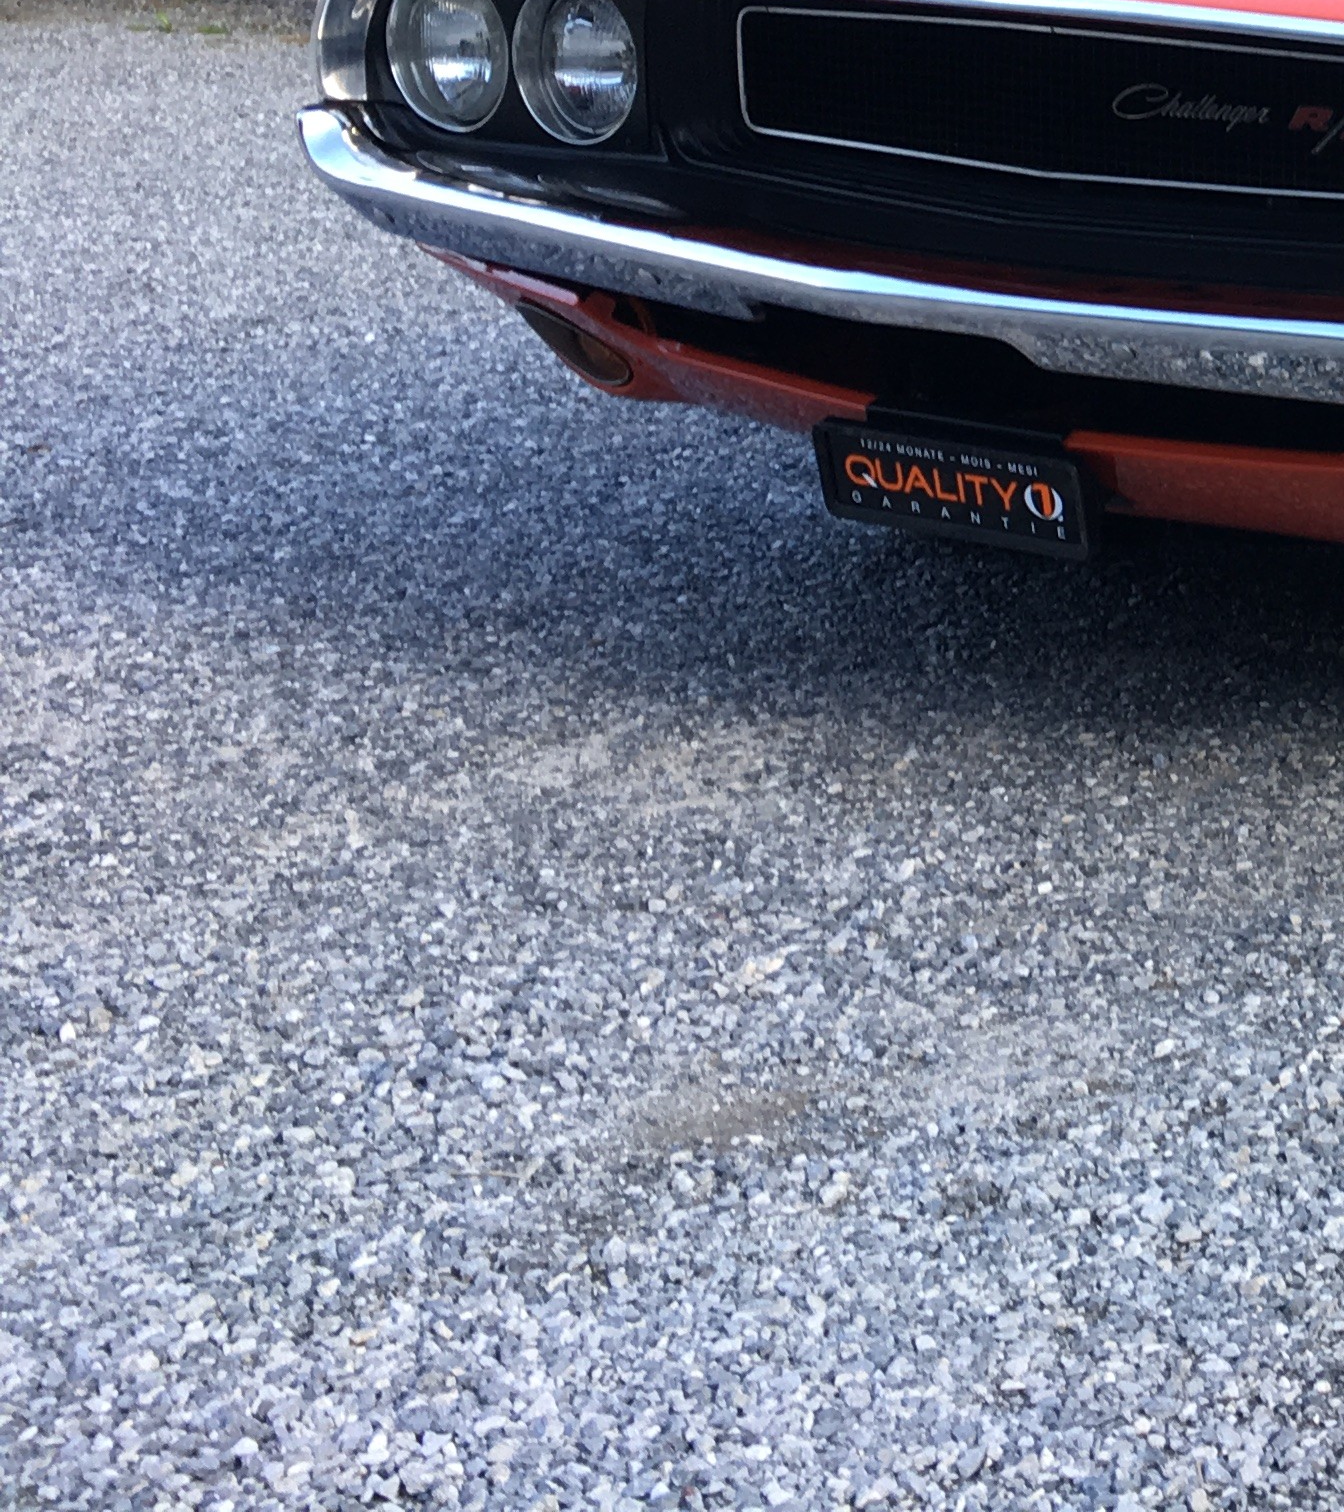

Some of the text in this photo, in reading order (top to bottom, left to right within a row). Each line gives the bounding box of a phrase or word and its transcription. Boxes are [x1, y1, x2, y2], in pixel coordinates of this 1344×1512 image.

[1112, 83, 1271, 133] Challenger
[896, 443, 945, 463] MONATE
[844, 454, 1018, 512] QUALITY
[852, 489, 1067, 540] GARANTIE
